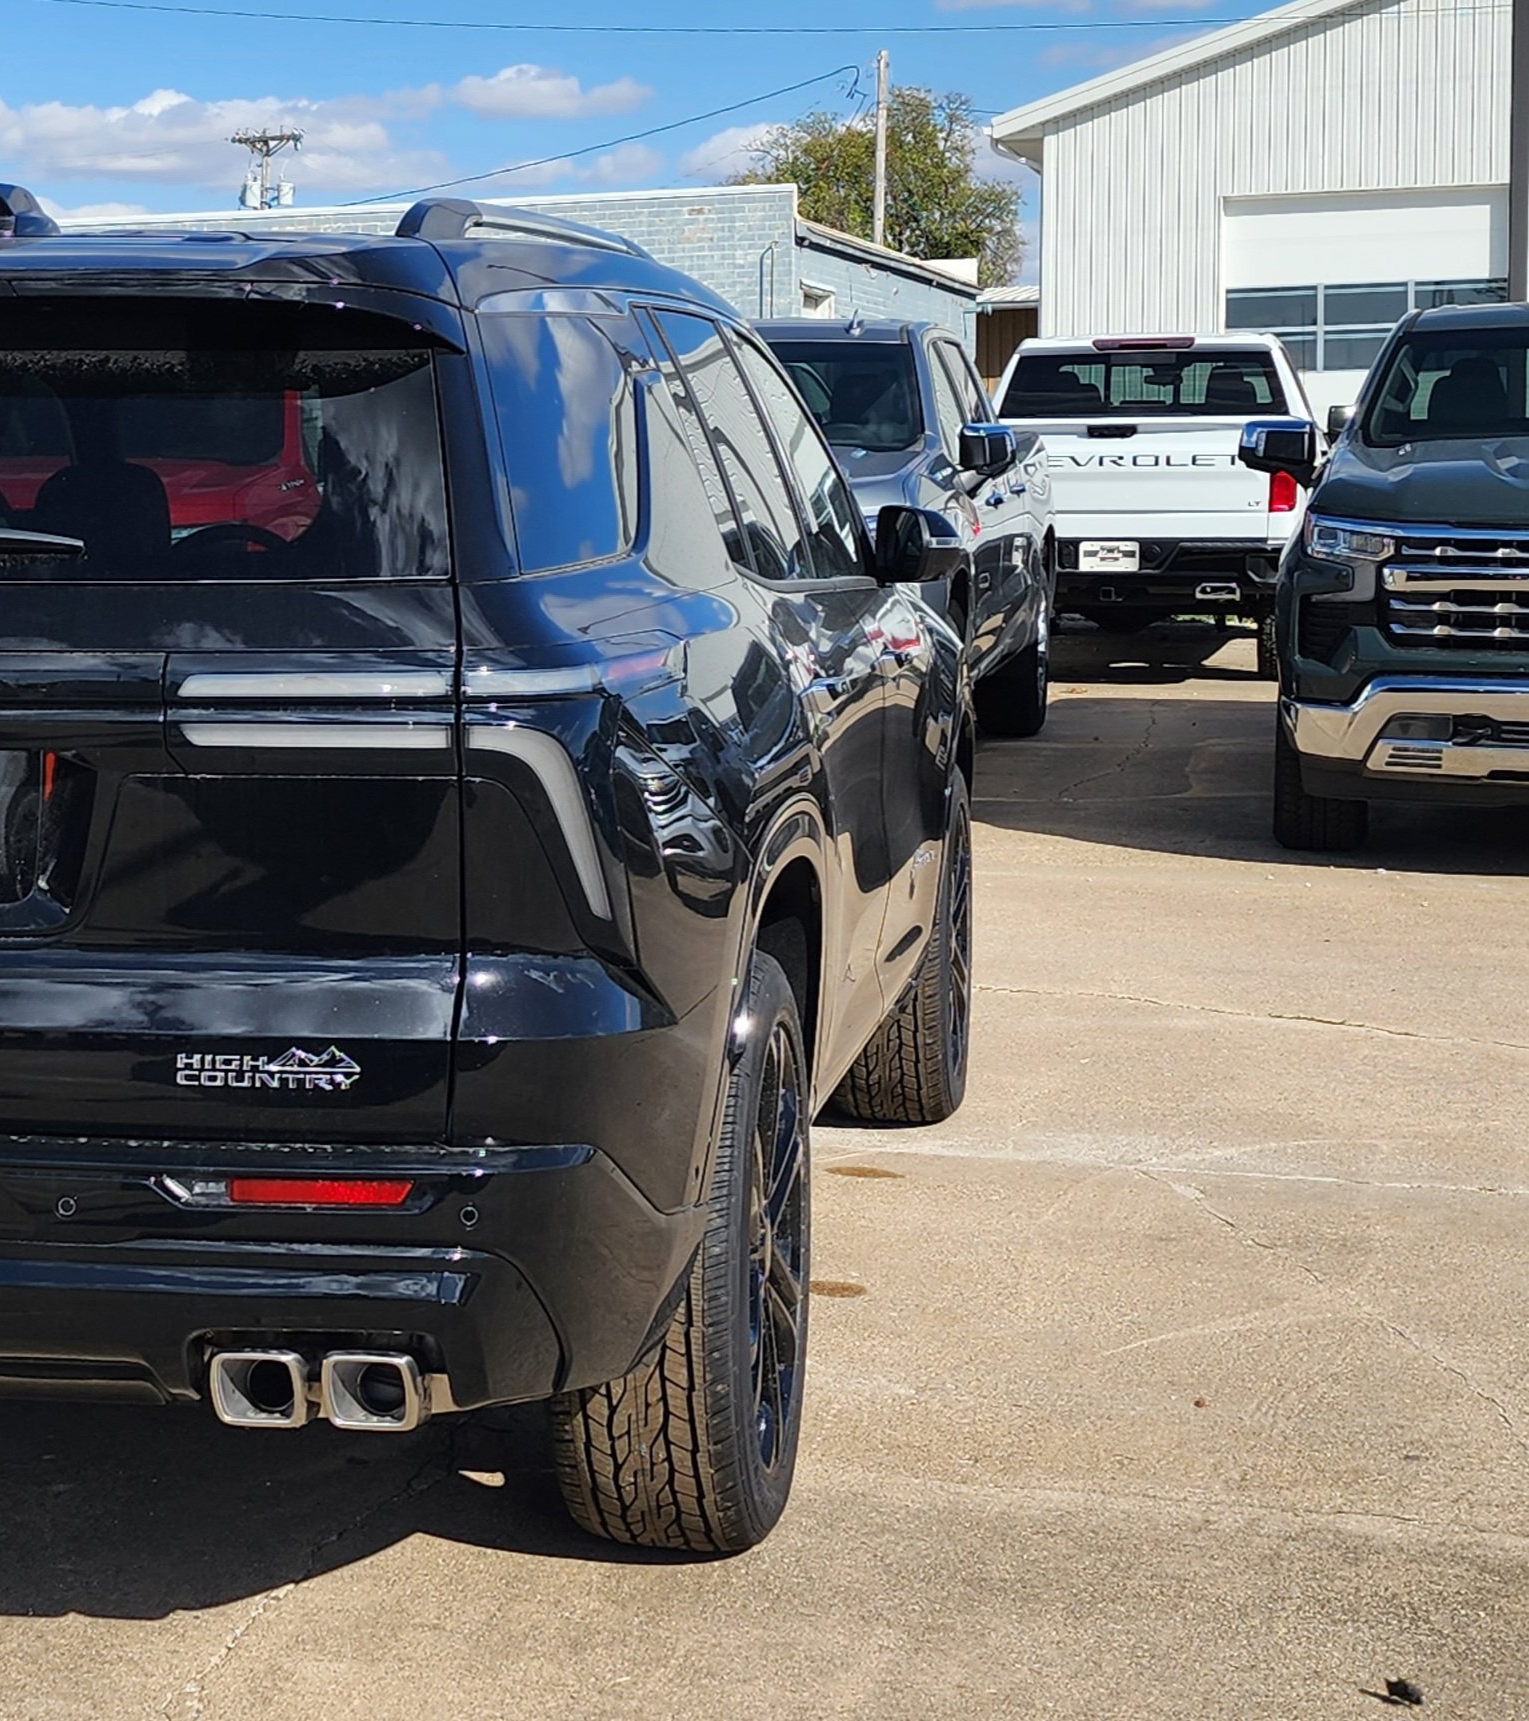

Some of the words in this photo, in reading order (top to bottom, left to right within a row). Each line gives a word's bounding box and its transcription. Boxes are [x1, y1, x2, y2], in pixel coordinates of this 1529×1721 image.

[1047, 454, 1238, 467] EVROLET
[176, 1053, 269, 1071] HIGH
[176, 1070, 361, 1091] COUNTRY
